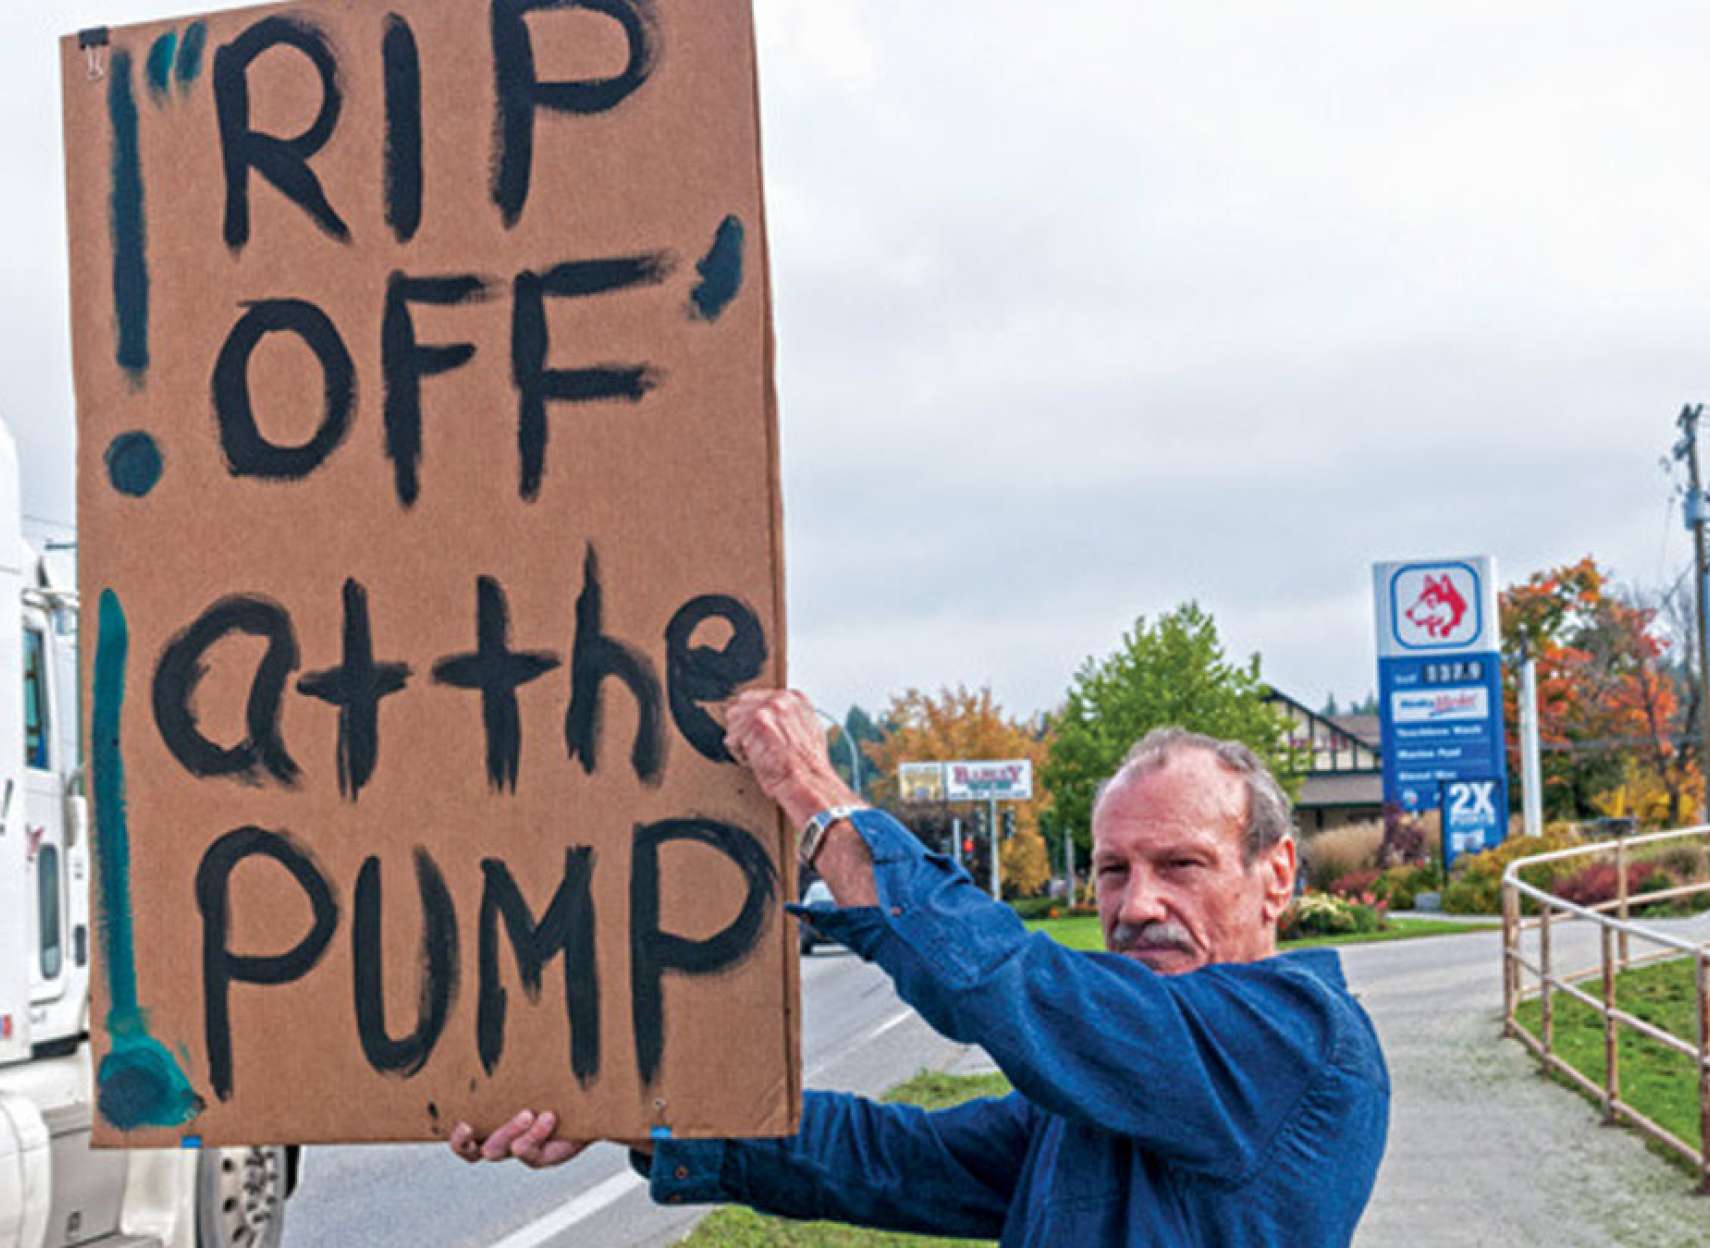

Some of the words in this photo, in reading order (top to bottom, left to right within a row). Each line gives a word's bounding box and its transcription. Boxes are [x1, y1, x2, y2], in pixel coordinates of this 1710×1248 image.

[152, 576, 413, 802] at
[431, 538, 768, 795] the
[1449, 782, 1495, 815] 2X
[195, 810, 780, 1100] PUMP
